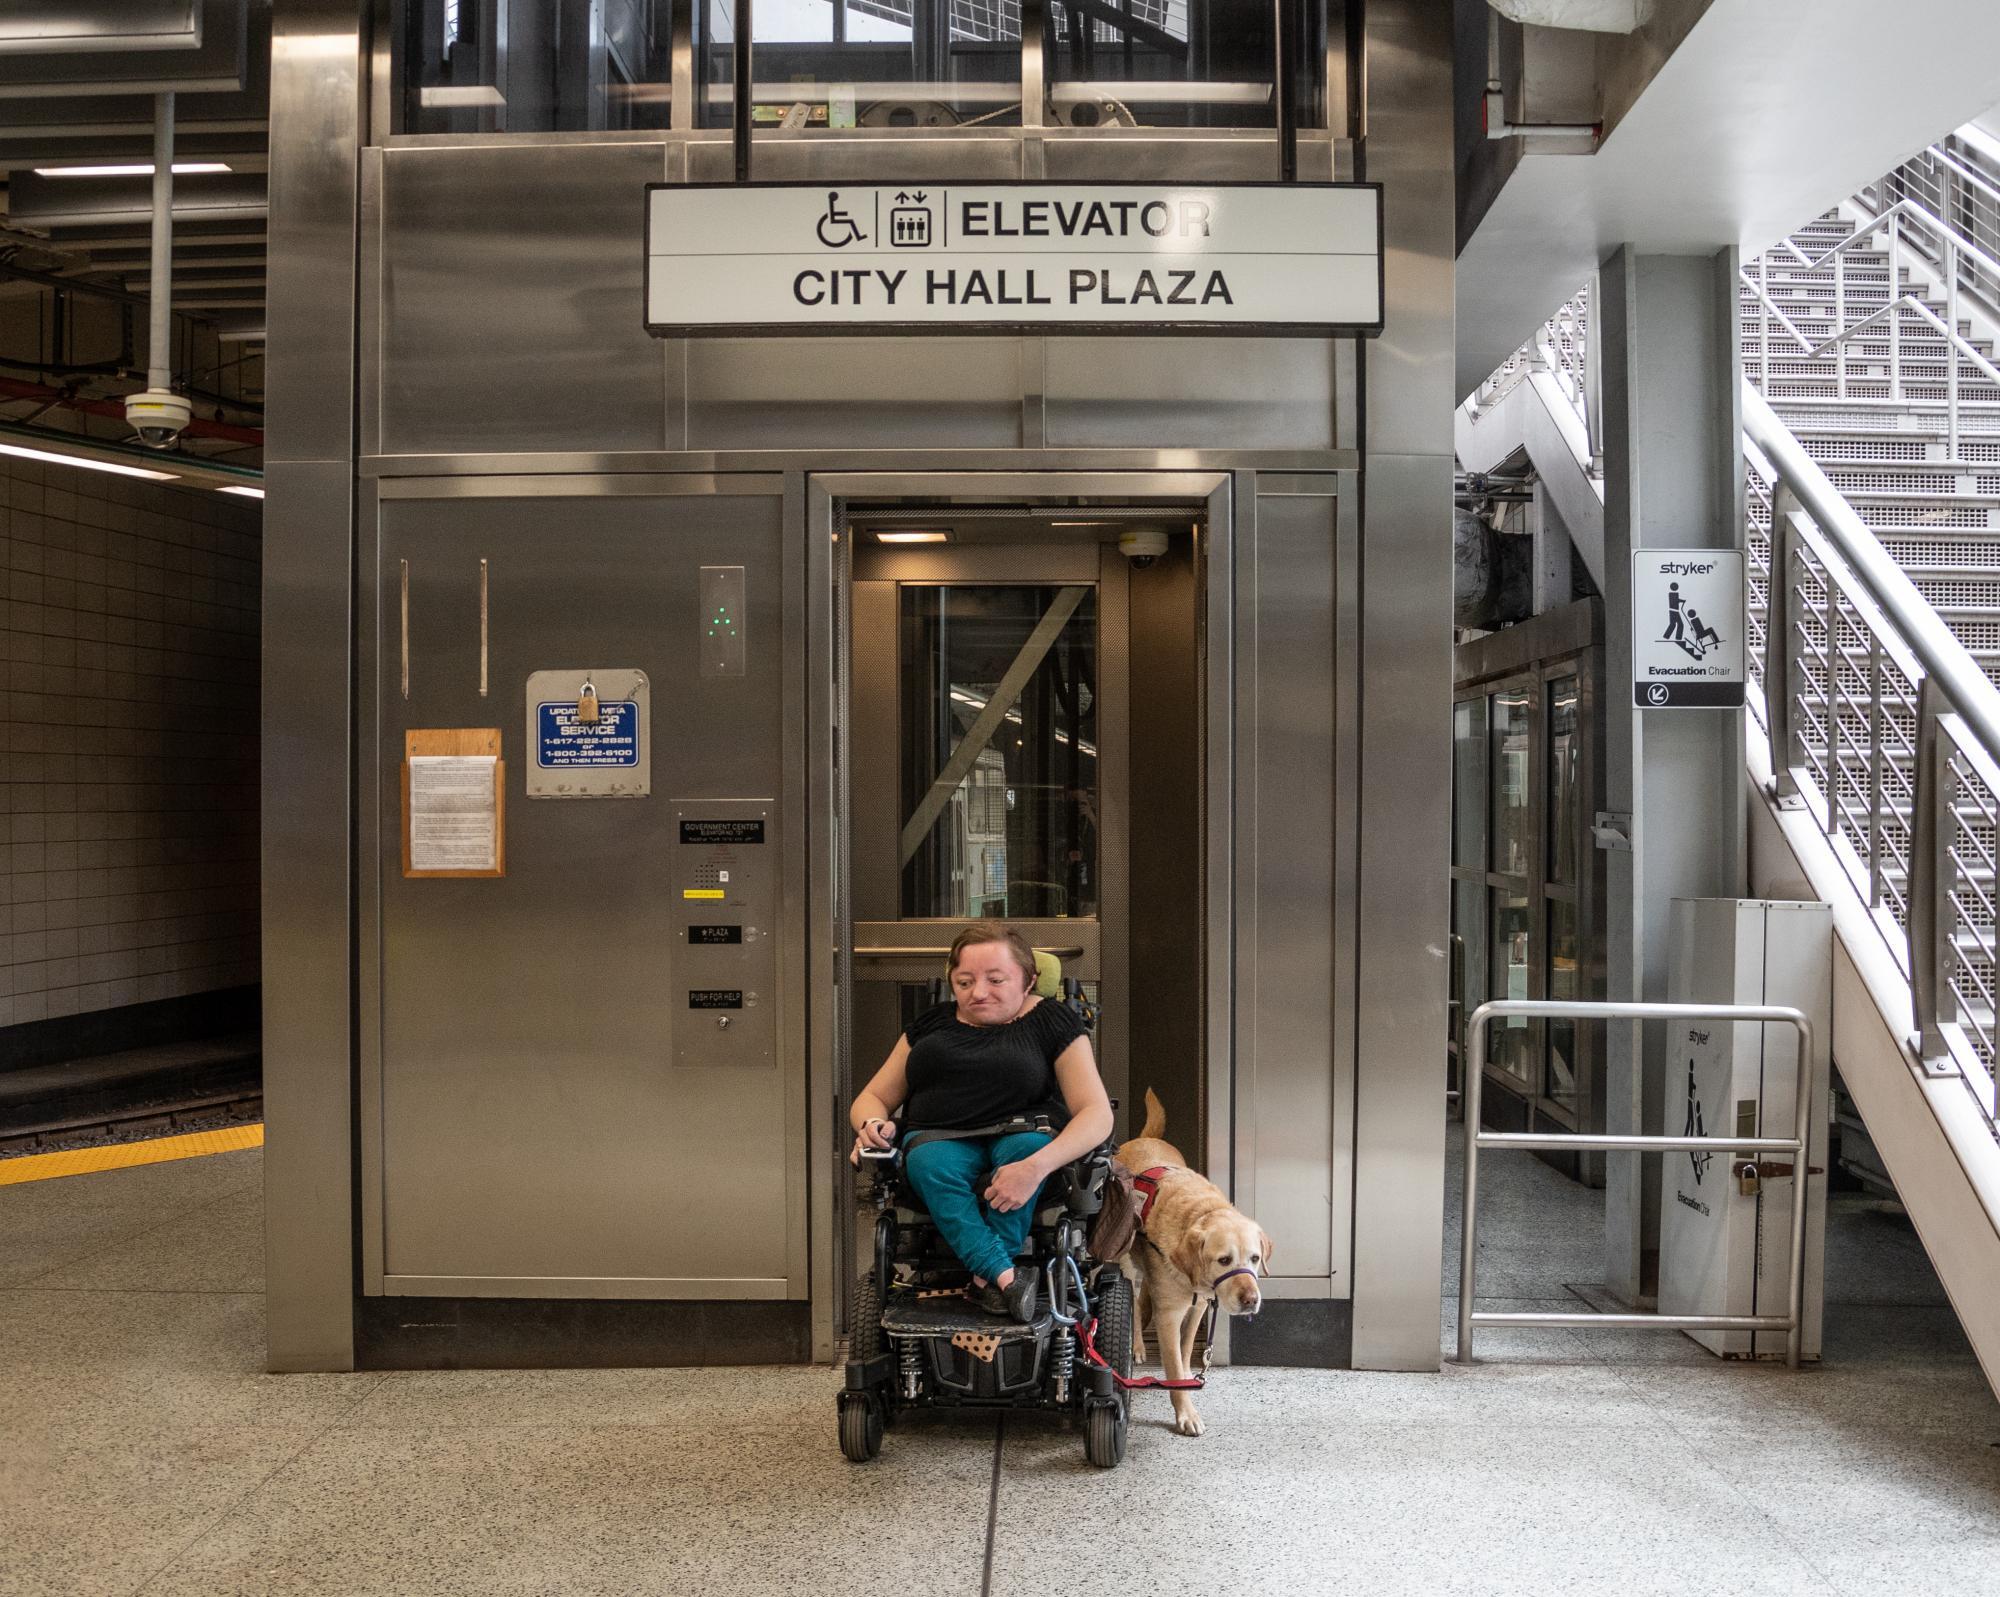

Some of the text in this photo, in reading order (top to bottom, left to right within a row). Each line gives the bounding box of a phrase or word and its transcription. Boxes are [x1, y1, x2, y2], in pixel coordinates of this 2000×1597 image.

[962, 201, 1212, 237] ELEVATOR
[793, 269, 1235, 306] CITY HALL PLAZA
[1659, 561, 1714, 576] stryker
[1648, 666, 1731, 676] Evacuation Chair
[556, 715, 620, 725] ELEOR
[560, 725, 615, 735] SERVICE
[708, 928, 729, 937] PLAZA
[691, 992, 741, 1001] PUSH FOR HELP
